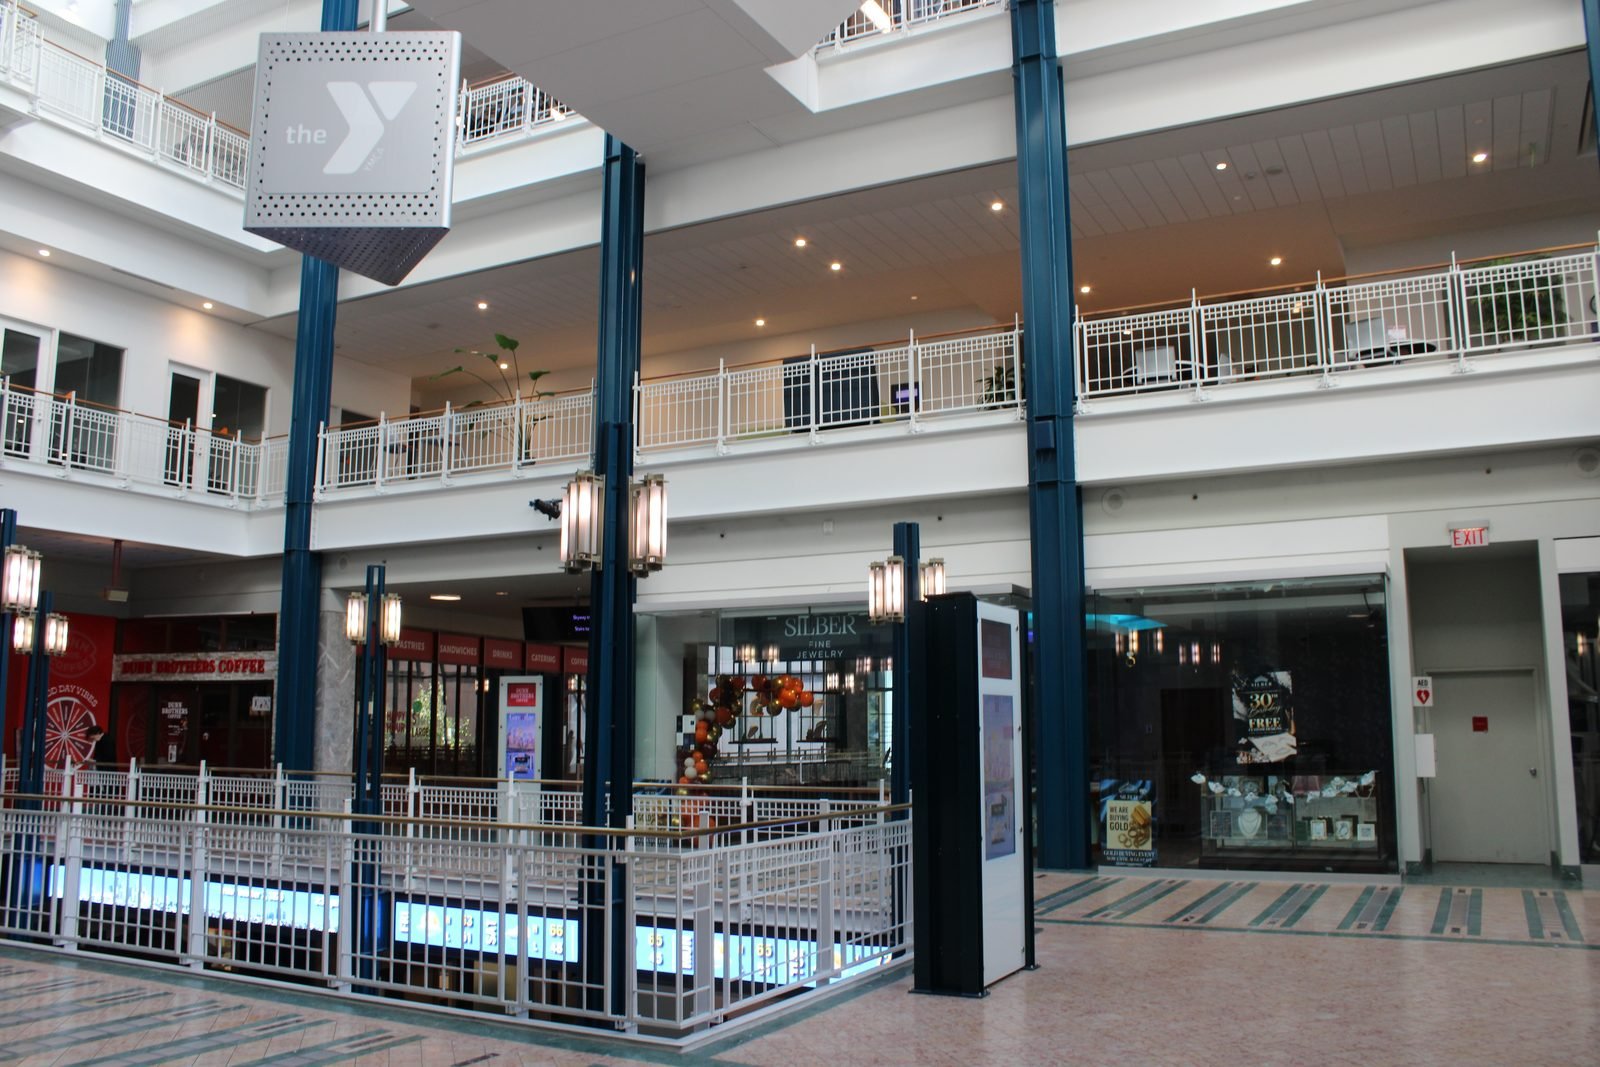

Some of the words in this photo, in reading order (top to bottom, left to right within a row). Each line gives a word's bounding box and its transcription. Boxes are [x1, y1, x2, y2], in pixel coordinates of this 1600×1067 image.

[286, 123, 328, 145] the
[1453, 529, 1485, 546] EXIT
[784, 615, 857, 637] SILBER
[440, 645, 478, 656] SANDWICHES
[808, 640, 832, 649] FINE
[531, 653, 556, 663] CATERING
[797, 650, 844, 660] JEWELRY
[121, 660, 153, 674] DUNN
[156, 660, 216, 674] BROTHERS
[218, 659, 265, 673] COFFEE
[58, 684, 76, 693] DAY
[76, 685, 98, 708] VIBES
[1248, 717, 1281, 729] FREE
[1109, 822, 1129, 831] GOLD
